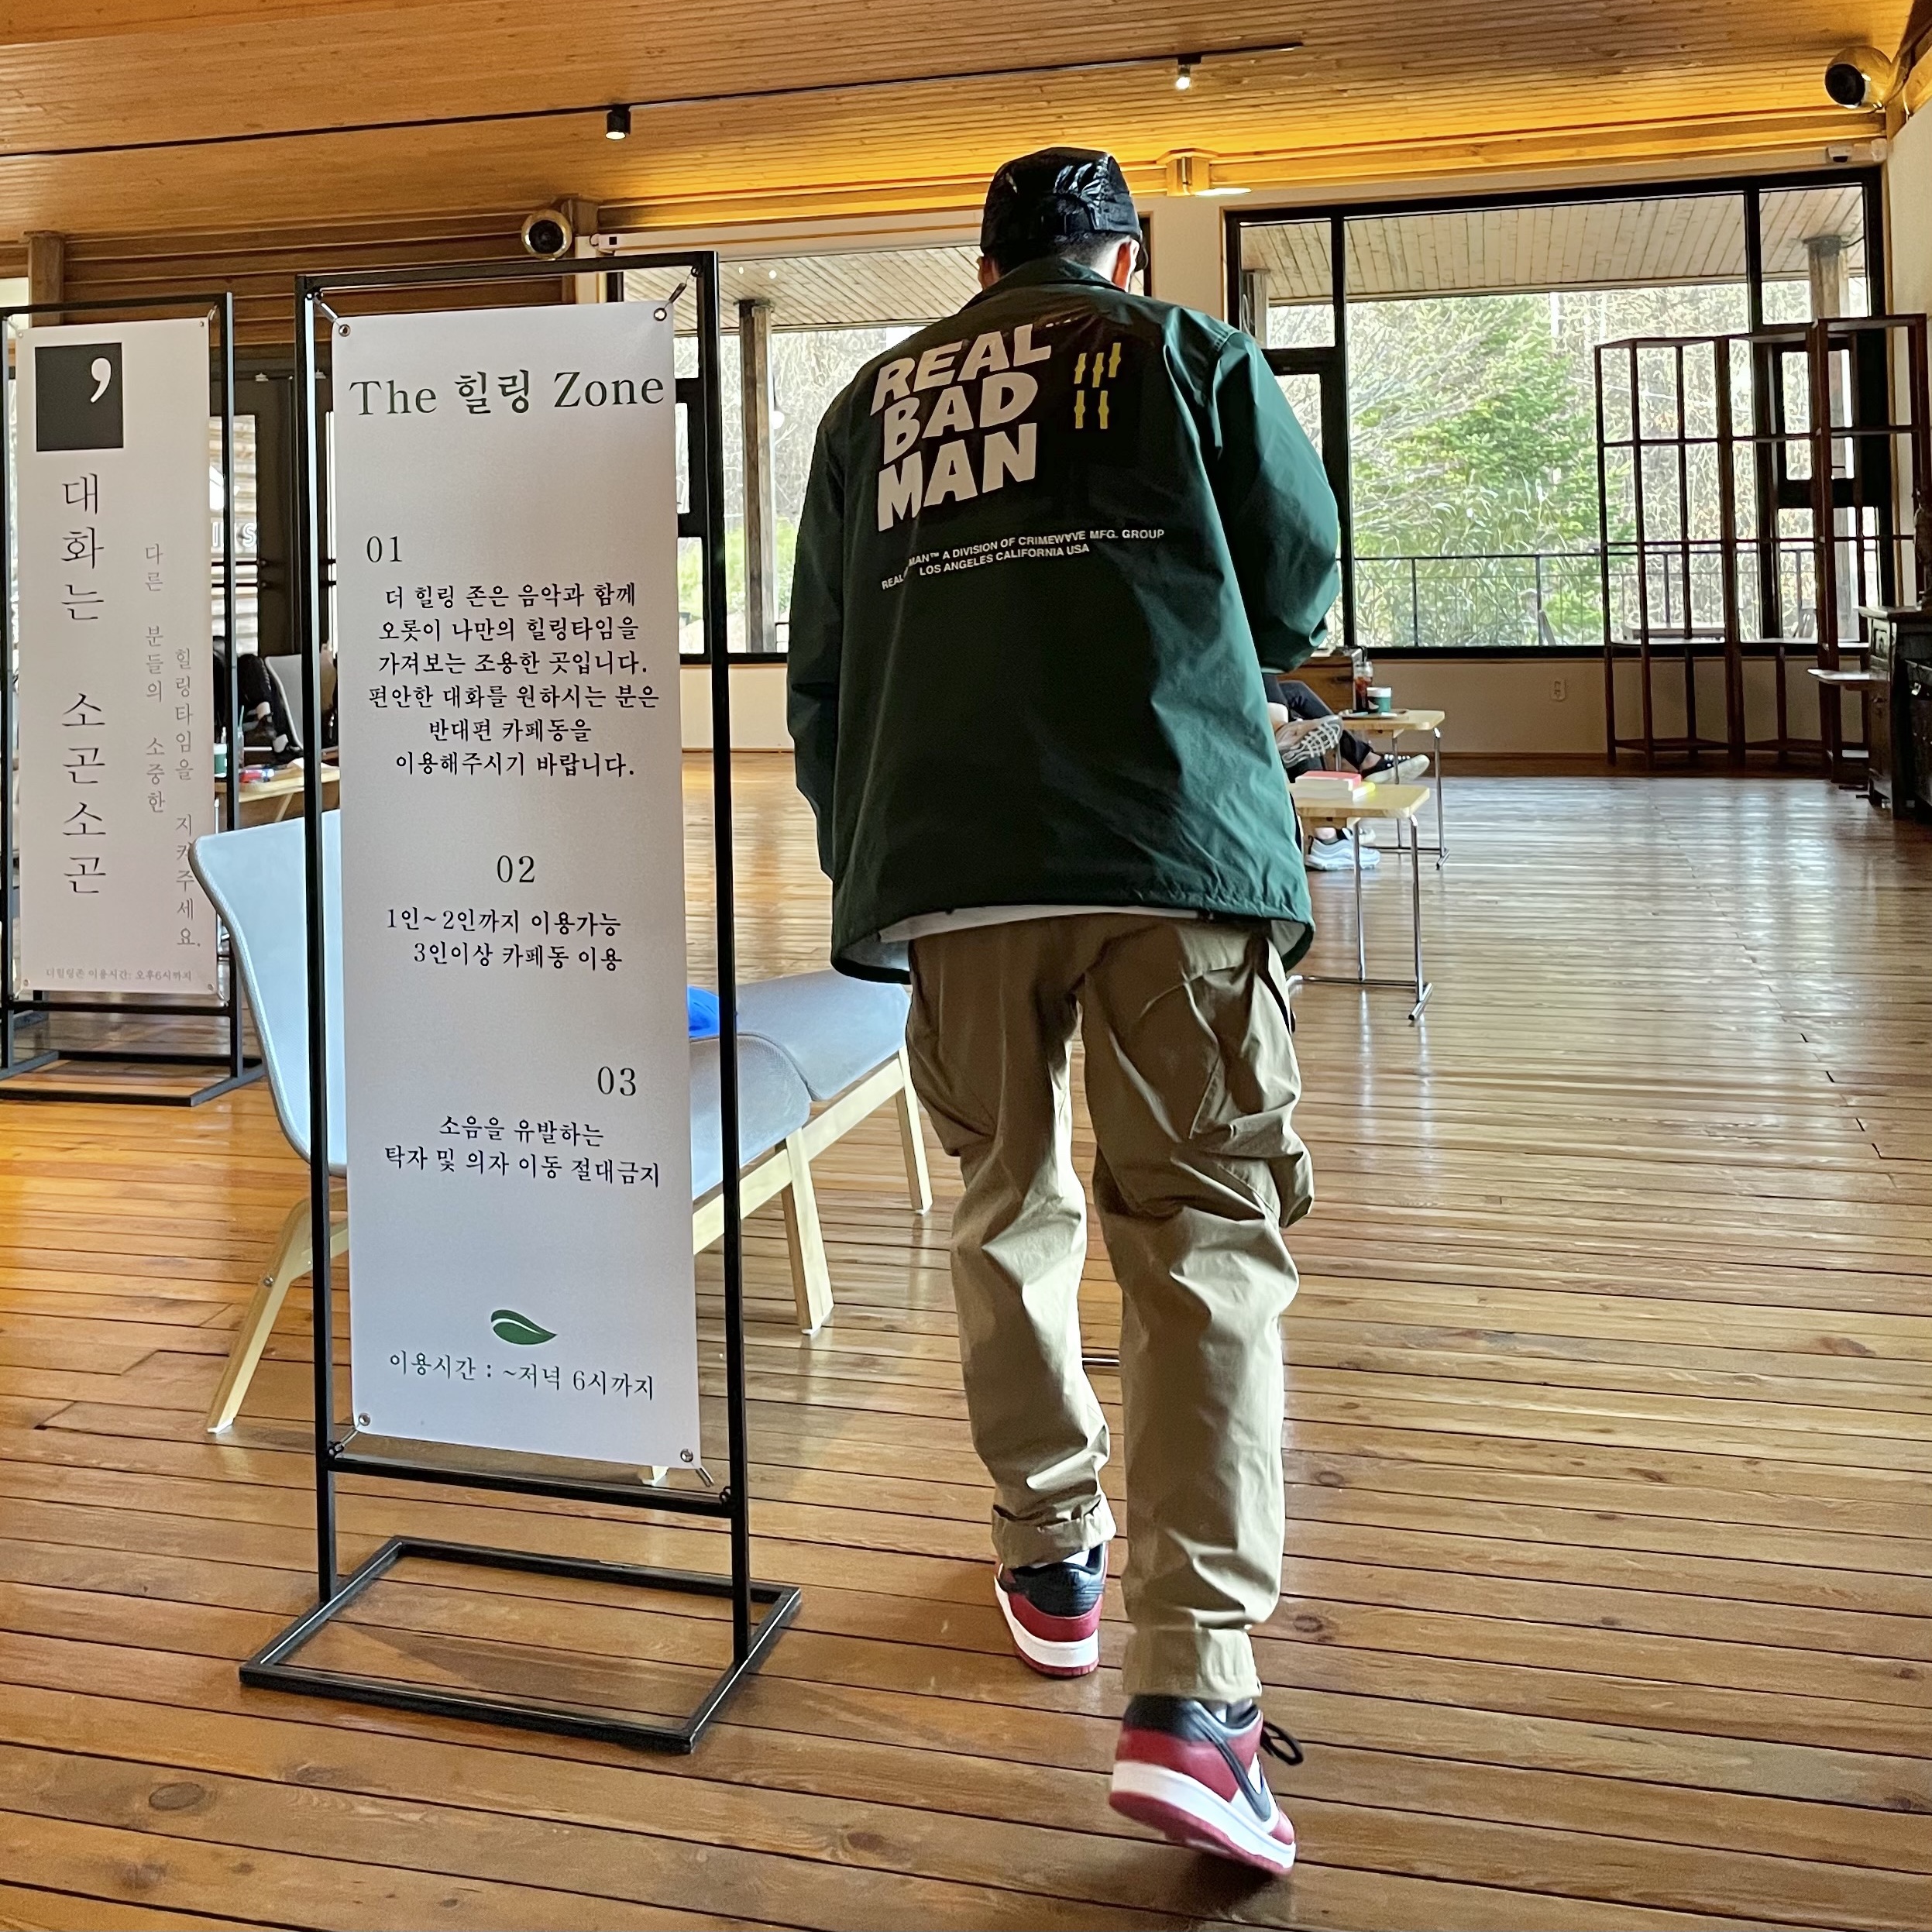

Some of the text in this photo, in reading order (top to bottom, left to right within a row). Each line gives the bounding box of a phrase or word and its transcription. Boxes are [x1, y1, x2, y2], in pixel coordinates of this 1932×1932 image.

[870, 324, 1052, 416] REAL
[349, 370, 663, 415] The 힐링 Zone
[882, 372, 1038, 466] BAD
[878, 423, 1037, 531] MAN
[367, 536, 401, 562] 01
[882, 575, 903, 589] REAL
[953, 541, 998, 558] DIVISION
[1001, 538, 1015, 547] OF
[1090, 530, 1118, 538] MFG.
[1122, 529, 1164, 538] GROUP
[920, 565, 941, 575] LOS
[943, 555, 993, 572] ANGELES
[996, 548, 1064, 560] CALIFORNIA
[1067, 544, 1089, 555] USA
[387, 583, 634, 609] 더 힐링 존은 음악과 함께
[380, 617, 638, 641] 오롯이 나만의 힐링타임을
[146, 544, 165, 813] 다른 분들의 소중한
[380, 651, 646, 676] 가져보는 조용한 곳입니다.
[62, 474, 105, 892] 대화는 소곤소곤
[370, 685, 658, 708] 편안한 대화를 원하시는 분은
[175, 648, 193, 780] 힐링타임을
[430, 718, 591, 742] 반대편 카페동을
[397, 751, 634, 777] 이용해주시기 바랍니다.
[497, 855, 535, 882] 02
[389, 907, 621, 937] 1인~2인까지 이용가능
[414, 941, 622, 971] 3인이상 카페동 이용
[598, 1067, 635, 1095] 03
[440, 1116, 603, 1146] 소음을 유발하는
[385, 1145, 658, 1188] 탁자 및 의자 이동 절대금지
[390, 1350, 476, 1380] 이용시간
[574, 1371, 652, 1400] 6시까지
